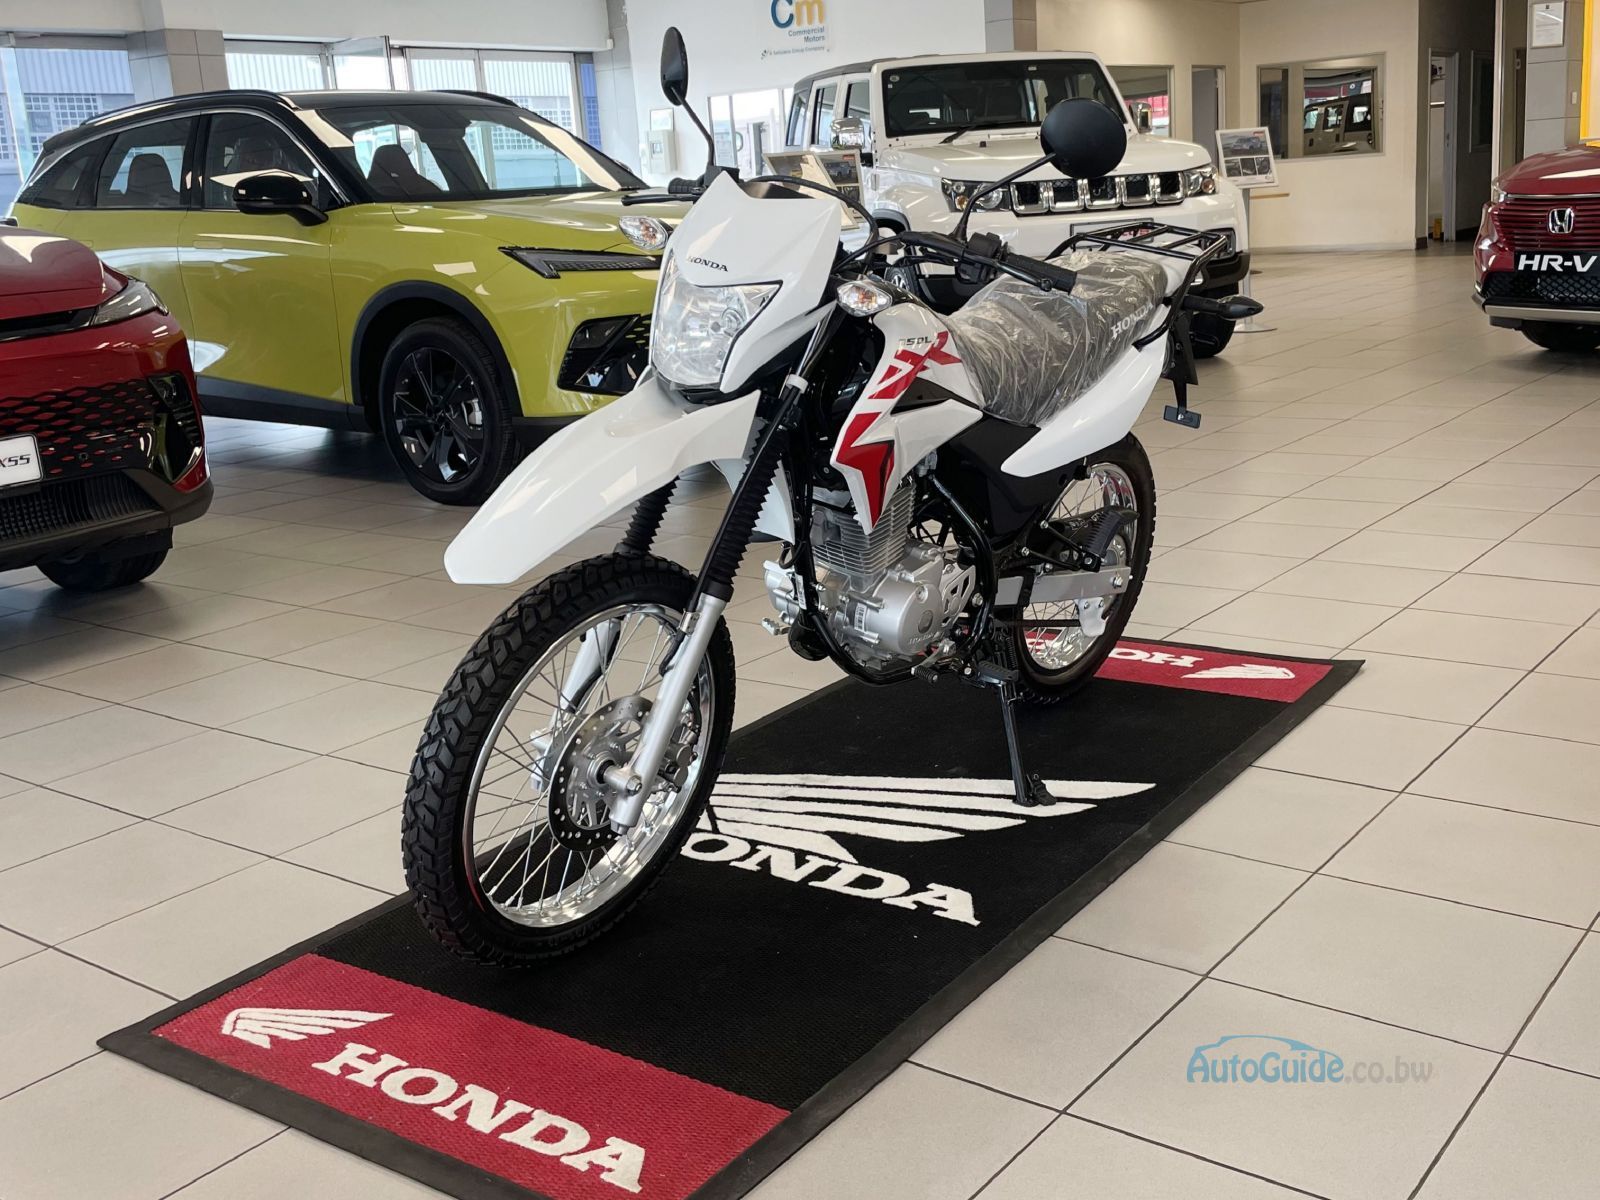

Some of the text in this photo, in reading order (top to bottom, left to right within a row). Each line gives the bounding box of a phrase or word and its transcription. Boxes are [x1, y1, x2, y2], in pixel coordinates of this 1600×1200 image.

[788, 26, 825, 37] Commercial
[804, 35, 825, 43] Motors
[1518, 254, 1598, 273] HR-V
[1111, 303, 1154, 340] HONDA
[680, 832, 981, 927] ONDA
[312, 1042, 646, 1194] HONDA
